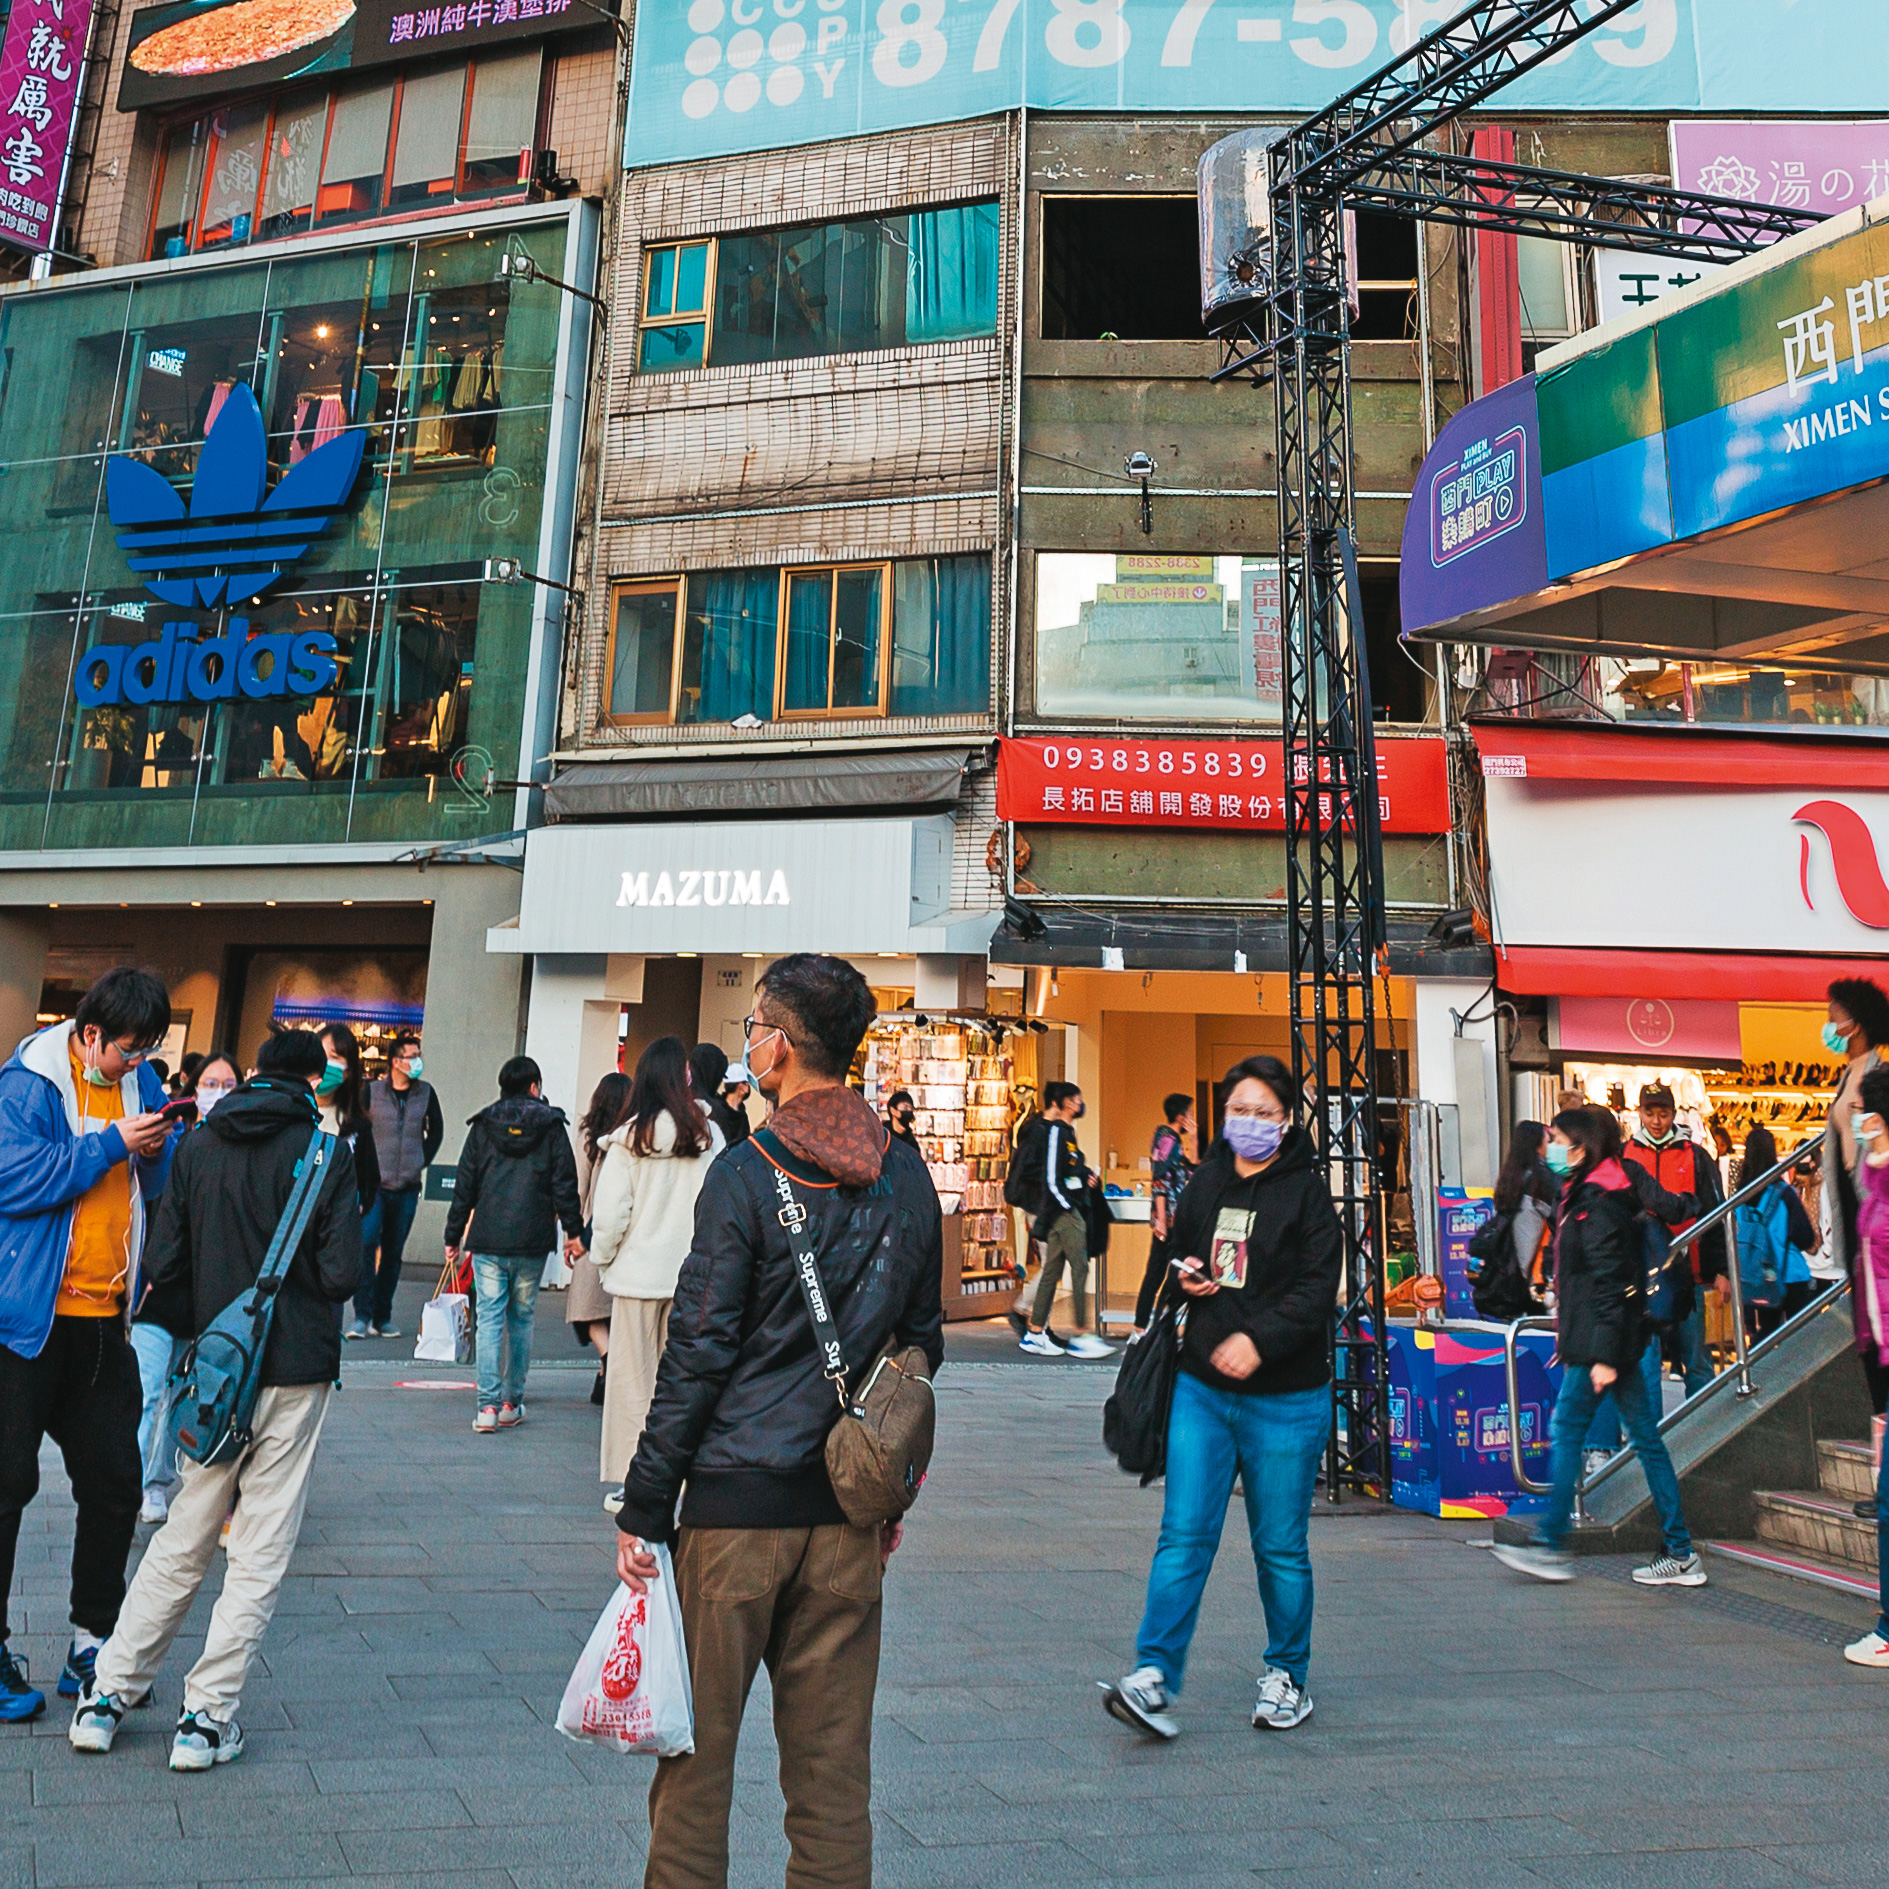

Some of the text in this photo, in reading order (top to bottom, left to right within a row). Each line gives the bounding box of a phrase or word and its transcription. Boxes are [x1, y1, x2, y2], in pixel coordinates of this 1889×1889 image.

[1783, 395, 1872, 453] XIMEN
[1464, 438, 1487, 461] XIMEN
[74, 617, 338, 708] adidas
[1043, 746, 1267, 778] 0938385839
[615, 868, 791, 908] MAZUMA
